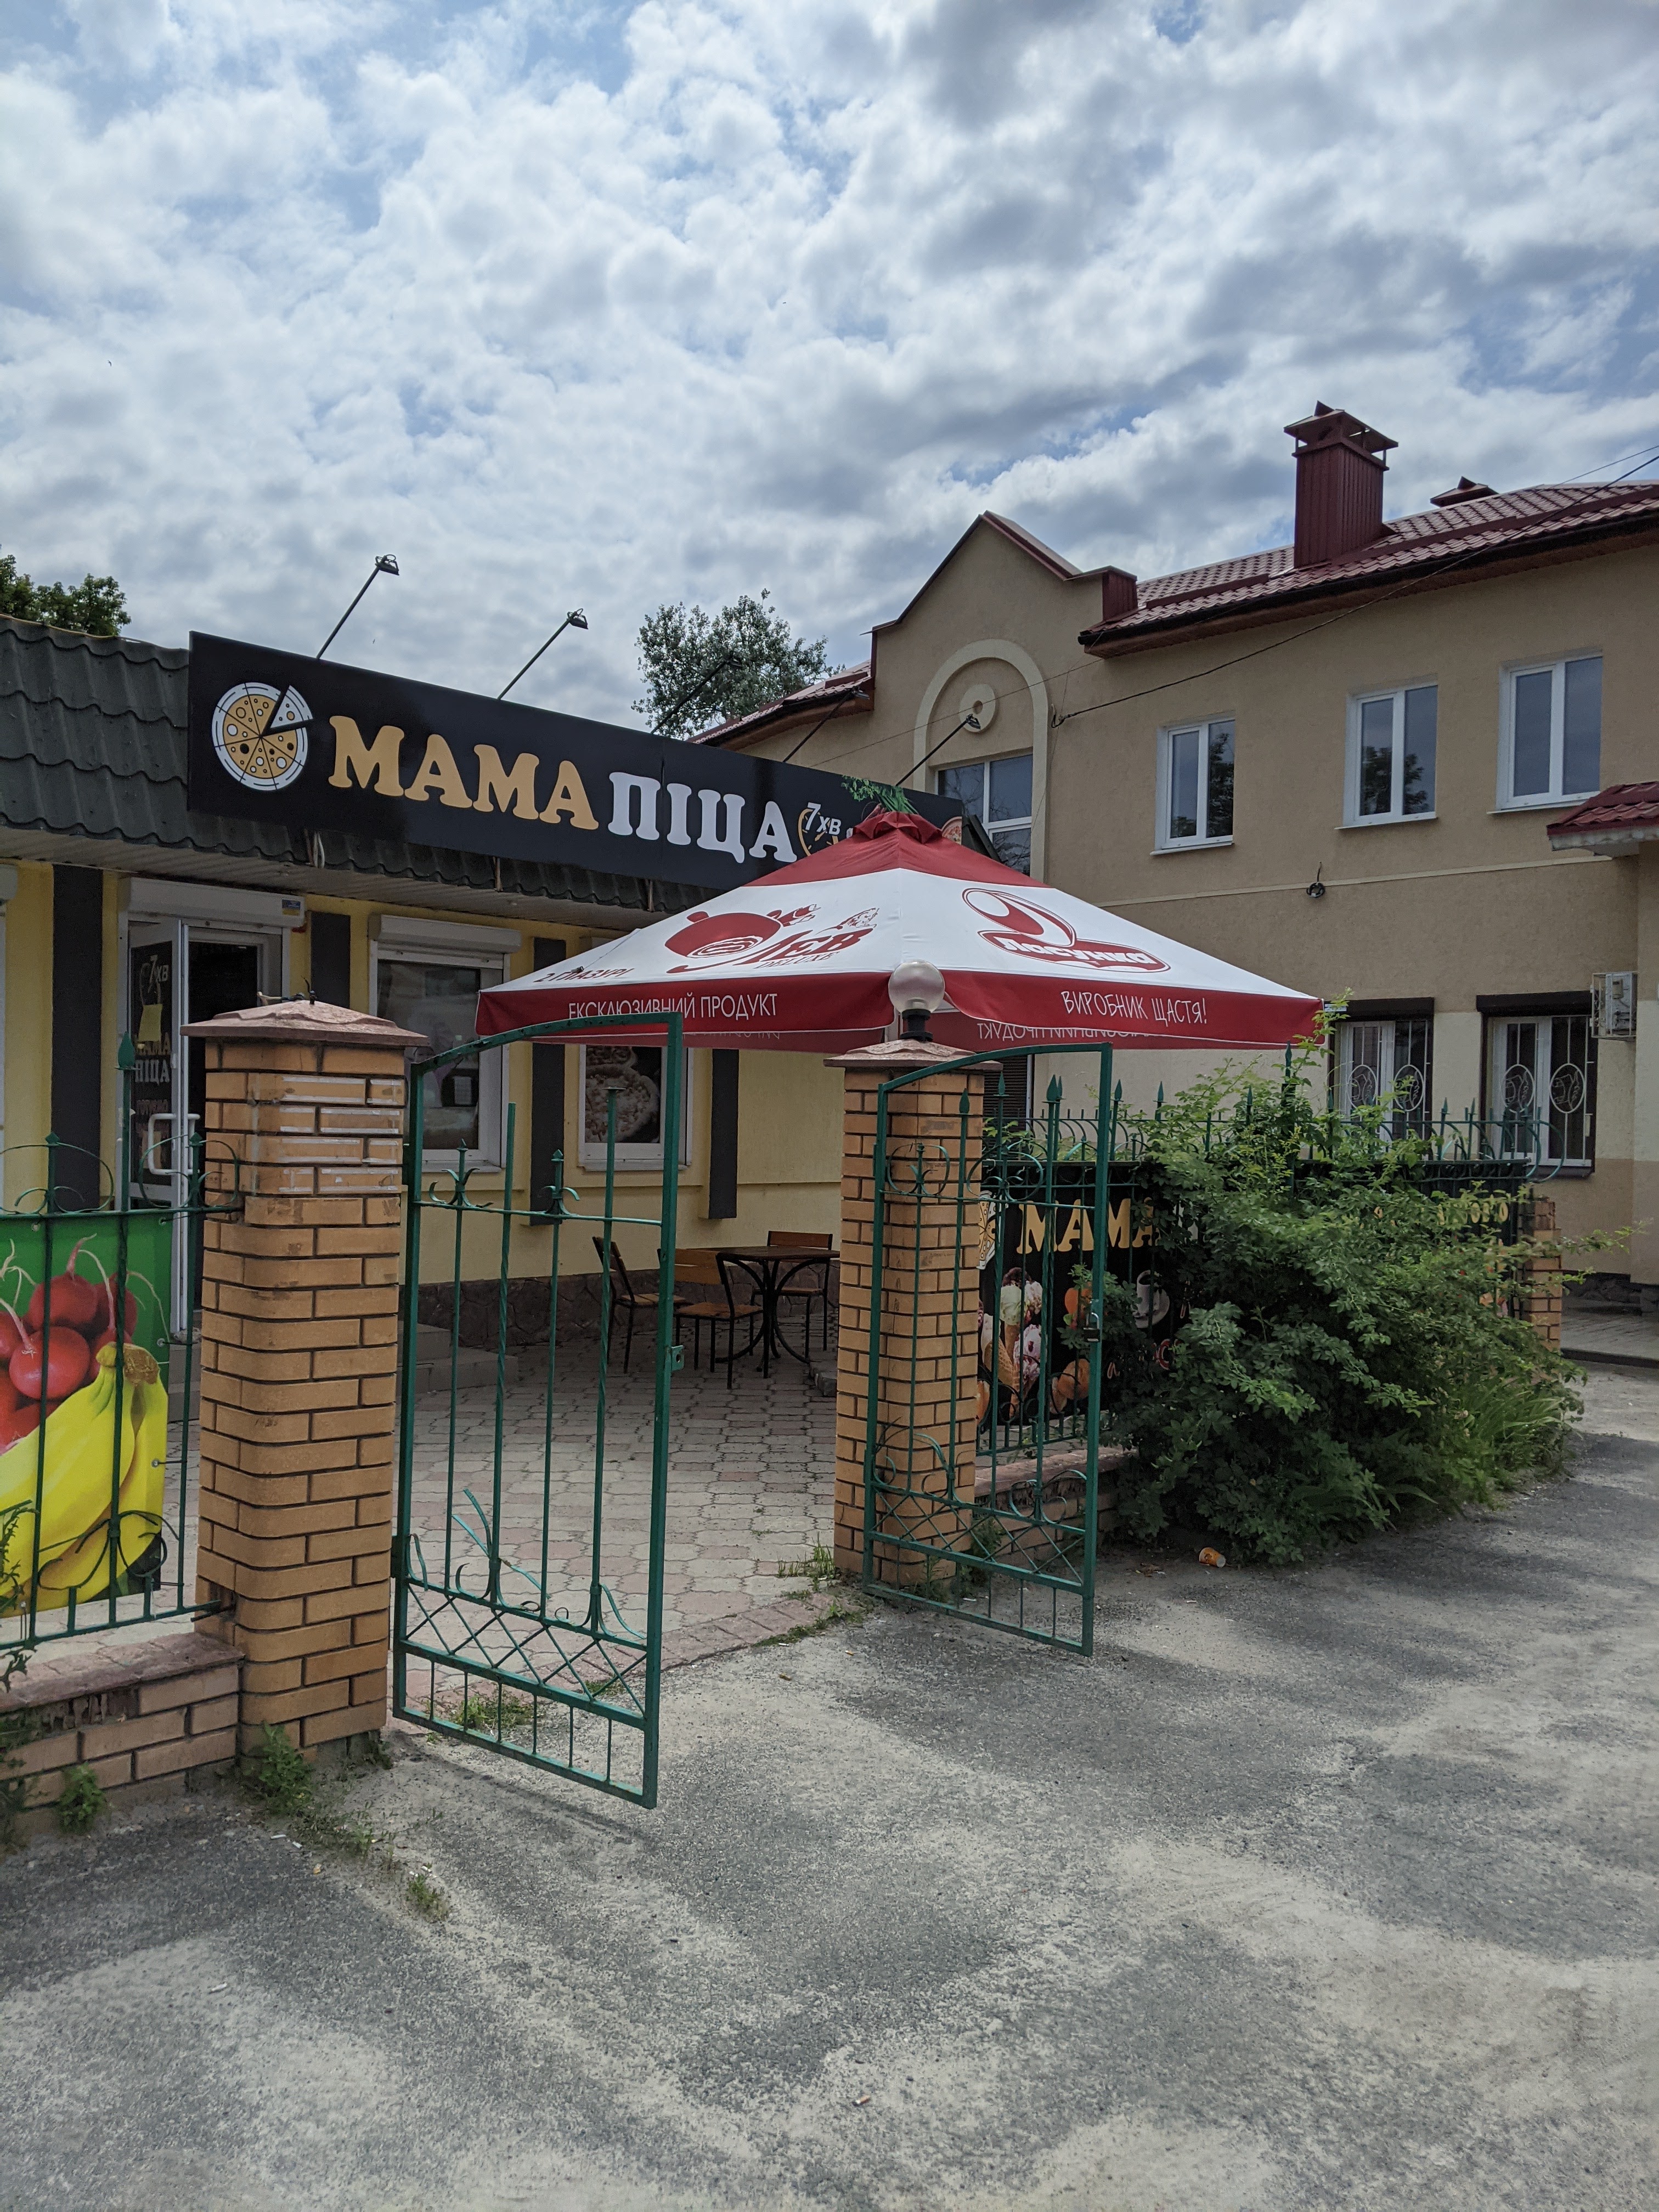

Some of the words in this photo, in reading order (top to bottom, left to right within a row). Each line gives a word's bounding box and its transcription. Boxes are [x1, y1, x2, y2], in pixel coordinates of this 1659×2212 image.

[328, 715, 599, 830] МАМА
[608, 772, 797, 864] ПІЦА
[805, 802, 821, 831] 7
[993, 936, 1158, 964] Ласунка
[568, 992, 695, 1019] ЕКСКЛЮЗИВНИЙ
[701, 994, 777, 1021] ПРОДУКТ
[1061, 990, 1148, 1020] ВИРОБНИК
[1152, 997, 1207, 1027] ЩАСТЯ!
[135, 1059, 170, 1086] ПІЦА
